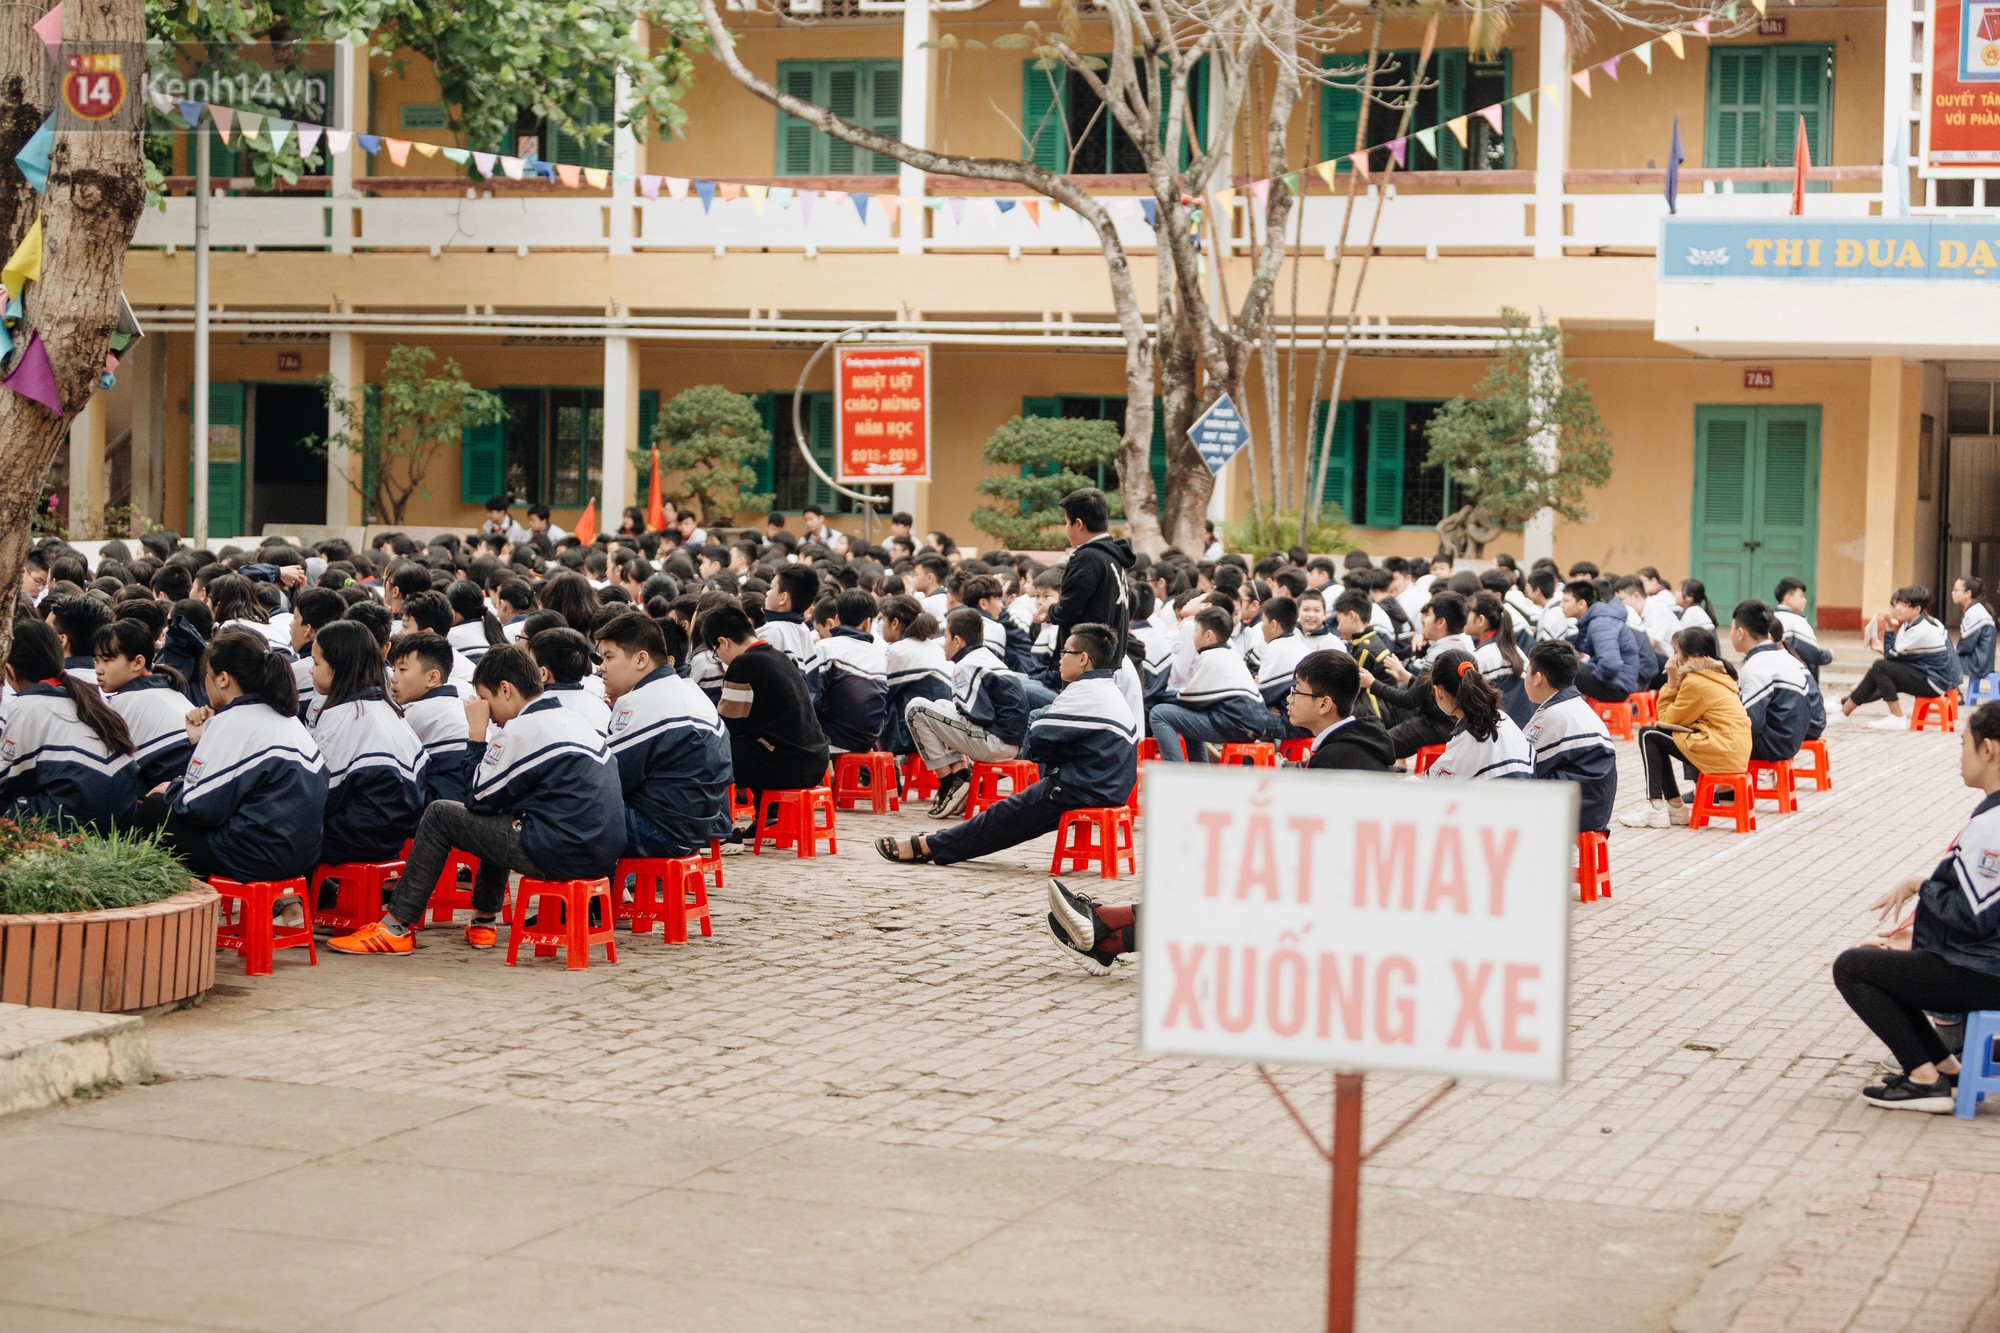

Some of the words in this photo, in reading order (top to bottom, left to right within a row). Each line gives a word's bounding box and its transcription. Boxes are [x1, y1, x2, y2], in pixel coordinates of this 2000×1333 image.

[1935, 89, 1976, 107] QUYẾT
[1945, 109, 1966, 126] VỚI
[1745, 238, 1821, 268] THI
[1834, 238, 1925, 269] ĐUA
[1937, 239, 2000, 276] DẠ
[851, 371, 887, 393] NHIỆT
[889, 371, 914, 393] LIỆT
[1746, 372, 1771, 386] 7A3
[844, 394, 879, 412] CHÀO
[881, 394, 921, 412] MỪNG
[854, 418, 884, 436] NĂM
[886, 421, 914, 440] HỌC
[1197, 778, 1326, 904] TẮT
[1352, 803, 1520, 916] MÁY
[1160, 922, 1417, 1046] XUỐNG
[1447, 957, 1541, 1053] XE
